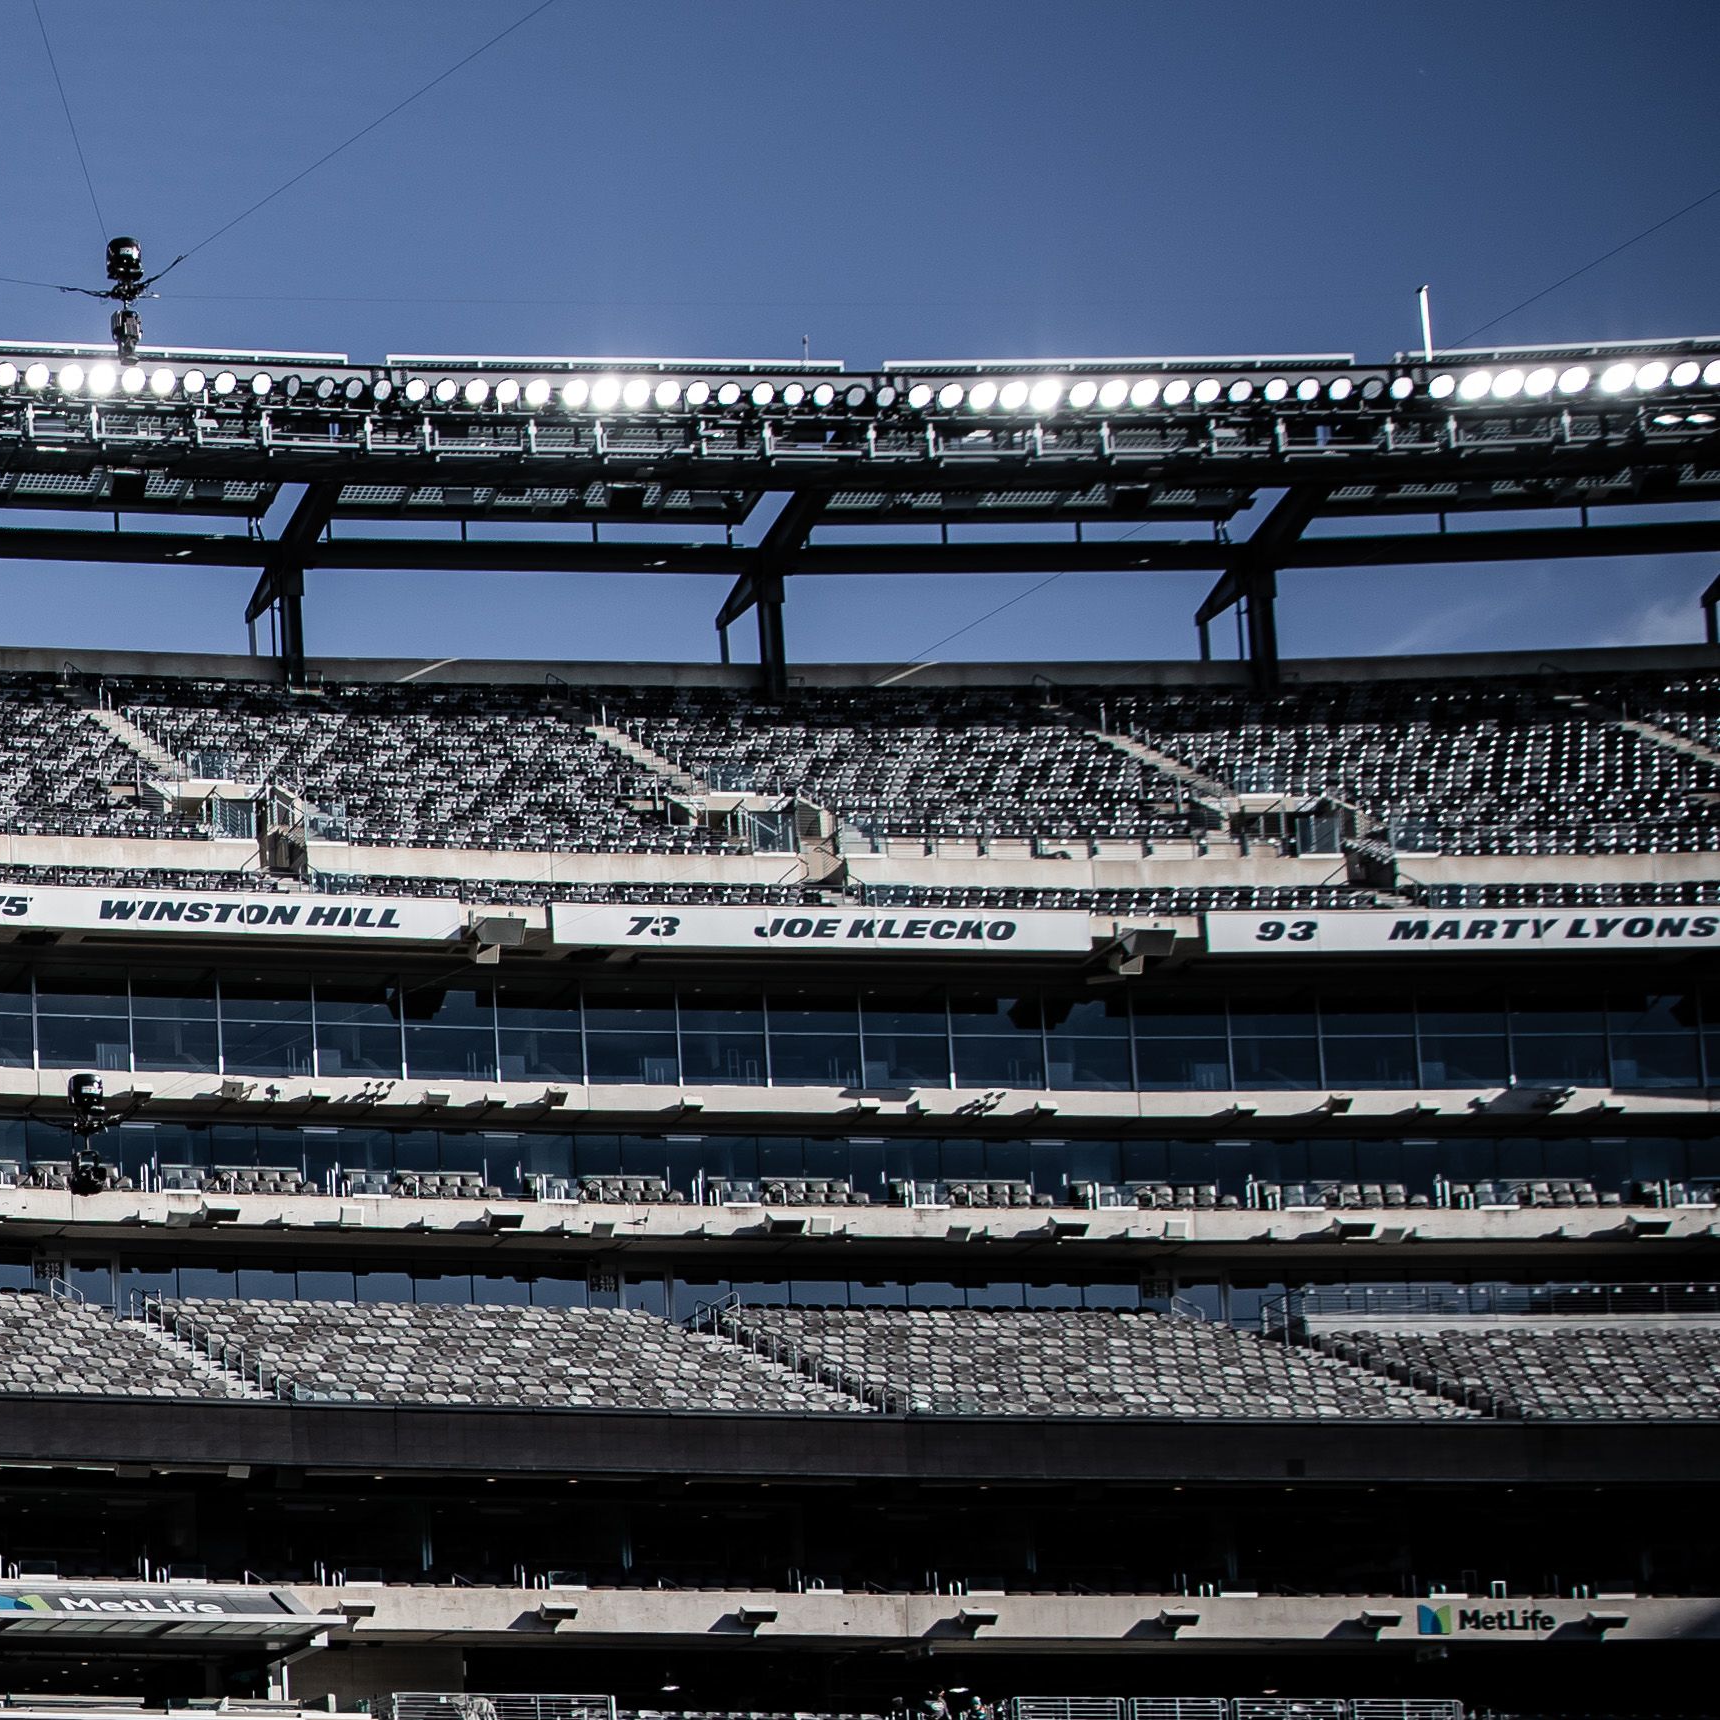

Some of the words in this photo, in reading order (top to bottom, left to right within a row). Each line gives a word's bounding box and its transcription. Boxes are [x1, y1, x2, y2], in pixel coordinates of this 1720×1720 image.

[98, 900, 302, 926] WINSTON
[305, 906, 402, 930] HILL
[625, 915, 681, 937] 73
[754, 917, 843, 939] JOE
[846, 918, 1017, 941] KLECKO
[1255, 920, 1318, 942] 93
[1388, 919, 1559, 941] MARTY
[1564, 915, 1720, 939] LYONS
[58, 1596, 226, 1614] MetLife
[1458, 1609, 1556, 1631] MetLife
